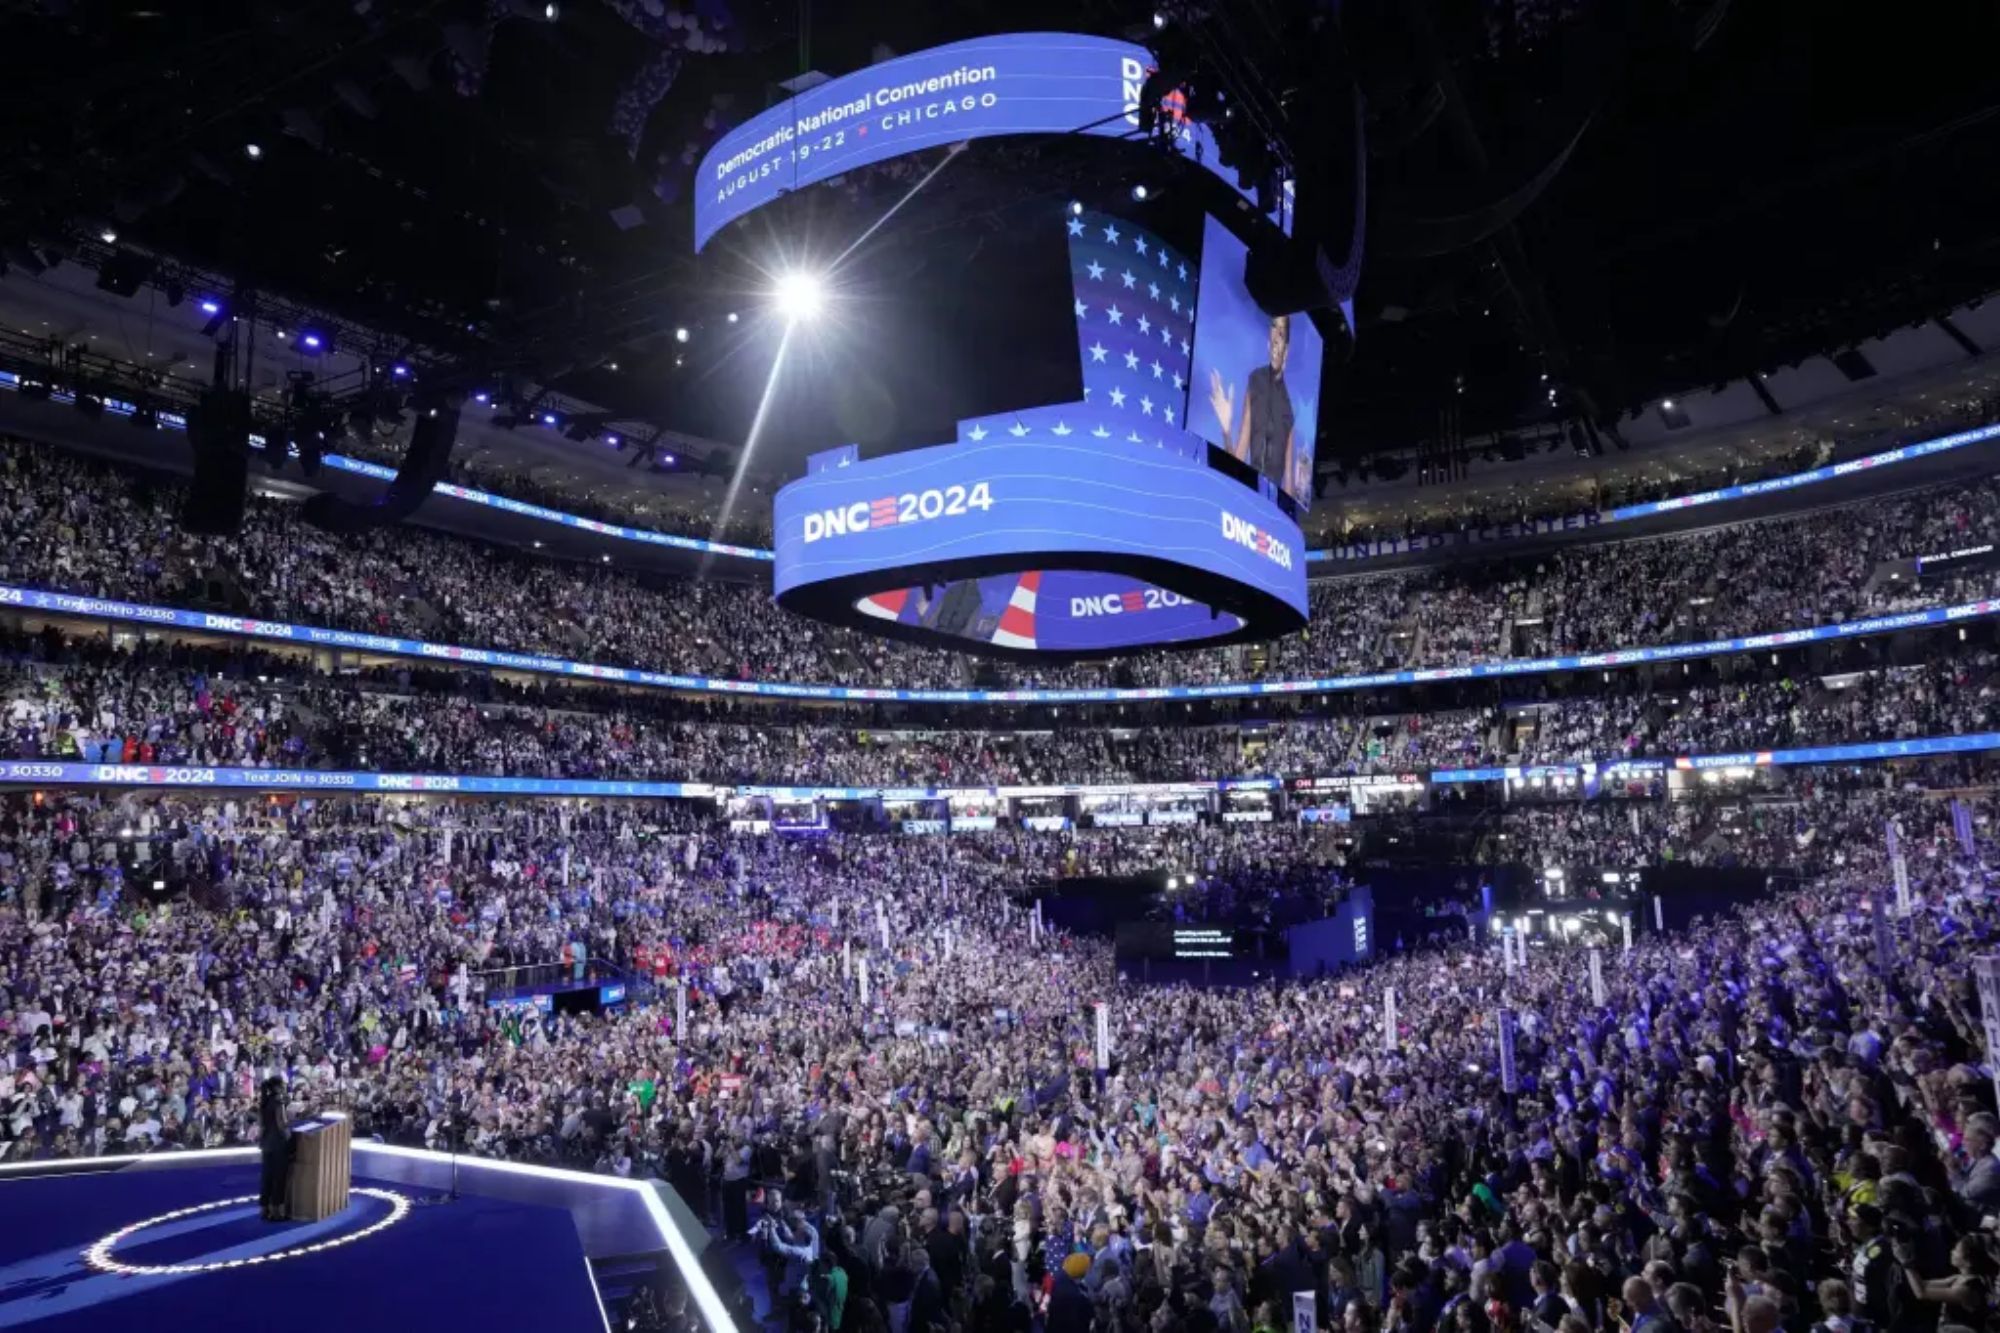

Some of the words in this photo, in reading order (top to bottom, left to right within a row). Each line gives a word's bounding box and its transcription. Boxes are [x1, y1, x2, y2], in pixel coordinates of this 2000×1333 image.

[717, 126, 794, 180] Democratic
[797, 93, 871, 136] National
[875, 65, 996, 106] Convention
[718, 157, 782, 204] AUGUST
[791, 131, 846, 163] 19-22
[881, 92, 997, 131] CHICAGO
[1834, 460, 1863, 475] DNC
[804, 505, 870, 543] DNC
[896, 482, 993, 524] 2024
[1221, 511, 1258, 550] DNC
[1265, 534, 1292, 570] 2024
[1332, 535, 1445, 560] UNITED
[1071, 594, 1123, 617] DNC
[1946, 604, 1977, 619] DNC
[205, 614, 243, 631] DNC
[254, 621, 292, 637] 2024
[9, 765, 64, 778] 30330
[98, 765, 150, 782] DNC
[165, 768, 216, 784] 2024
[243, 771, 269, 783] Text
[271, 773, 301, 784] JOIN
[378, 776, 412, 789] DNC
[424, 777, 459, 790] 2024
